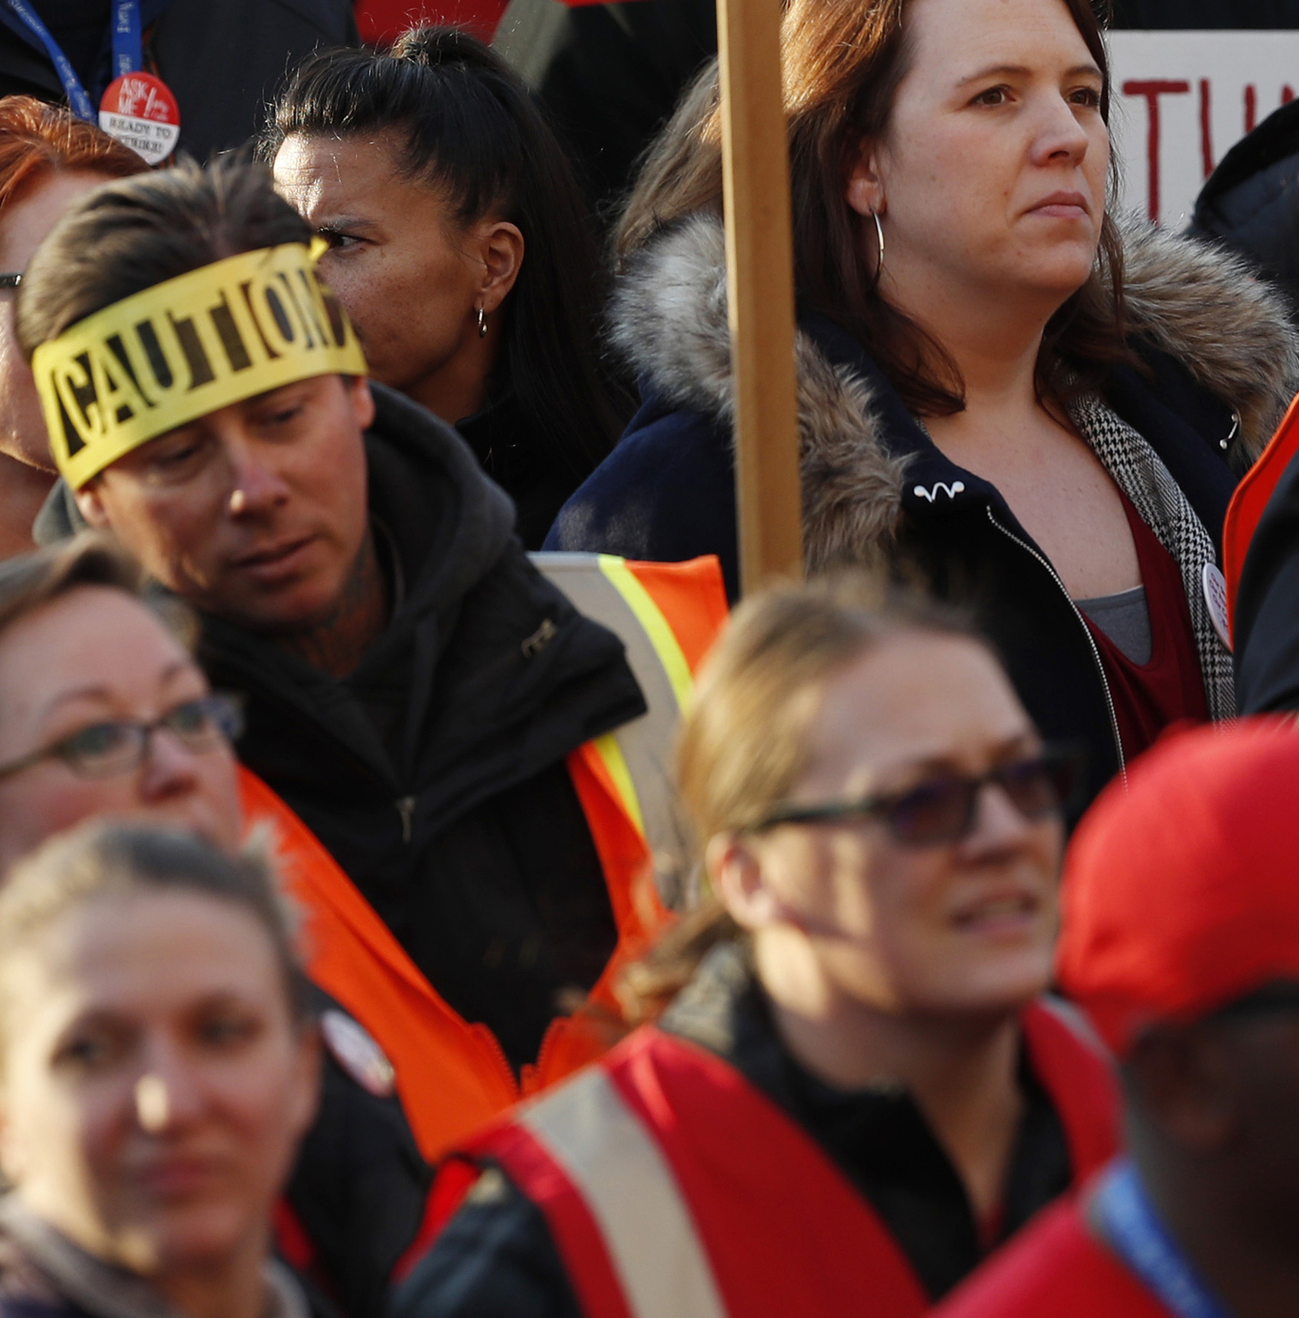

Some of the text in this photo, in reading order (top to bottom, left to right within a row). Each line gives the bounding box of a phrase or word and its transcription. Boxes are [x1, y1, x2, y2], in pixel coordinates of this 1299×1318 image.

[108, 117, 172, 140] READY TO
[52, 269, 342, 444] CAUTION
